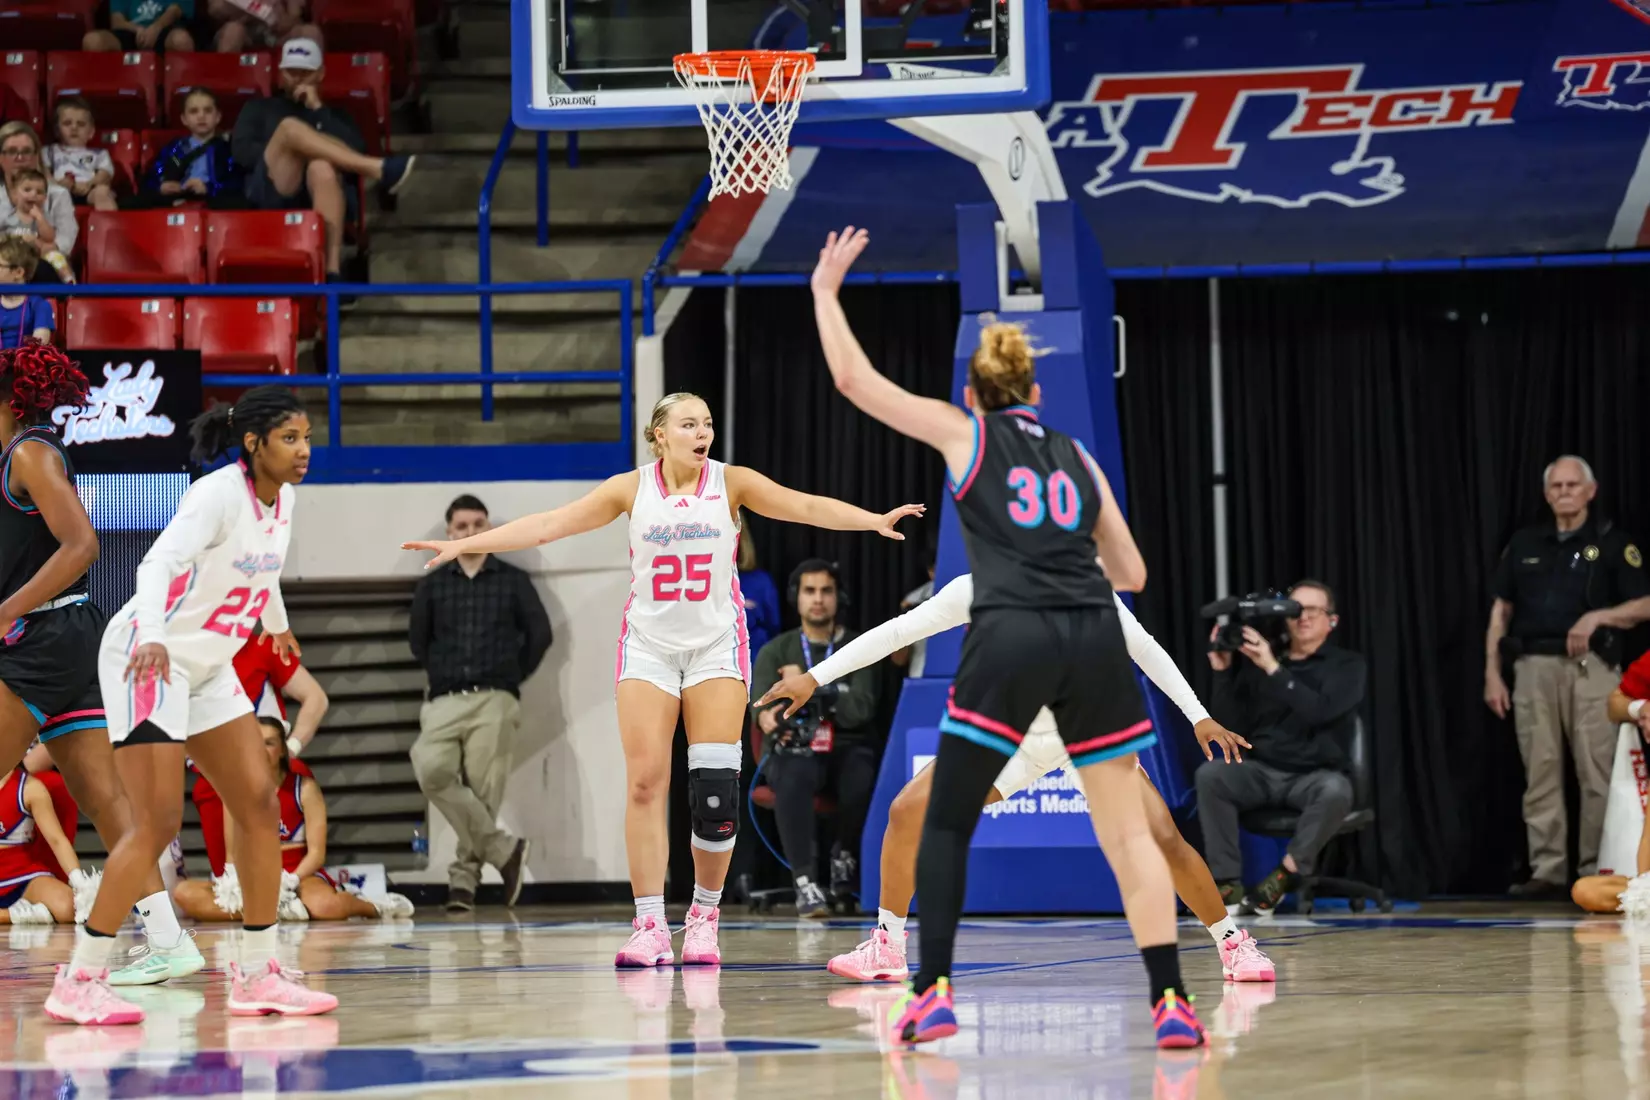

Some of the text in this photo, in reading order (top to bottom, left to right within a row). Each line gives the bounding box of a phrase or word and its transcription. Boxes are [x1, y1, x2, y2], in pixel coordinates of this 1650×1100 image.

[548, 95, 596, 108] SPALDING
[1083, 65, 1524, 172] TECH
[85, 360, 164, 415] Lady
[51, 400, 175, 447] Techsters
[1006, 466, 1083, 533] 30
[643, 522, 721, 548] Lady Techsters
[651, 553, 713, 602] 25
